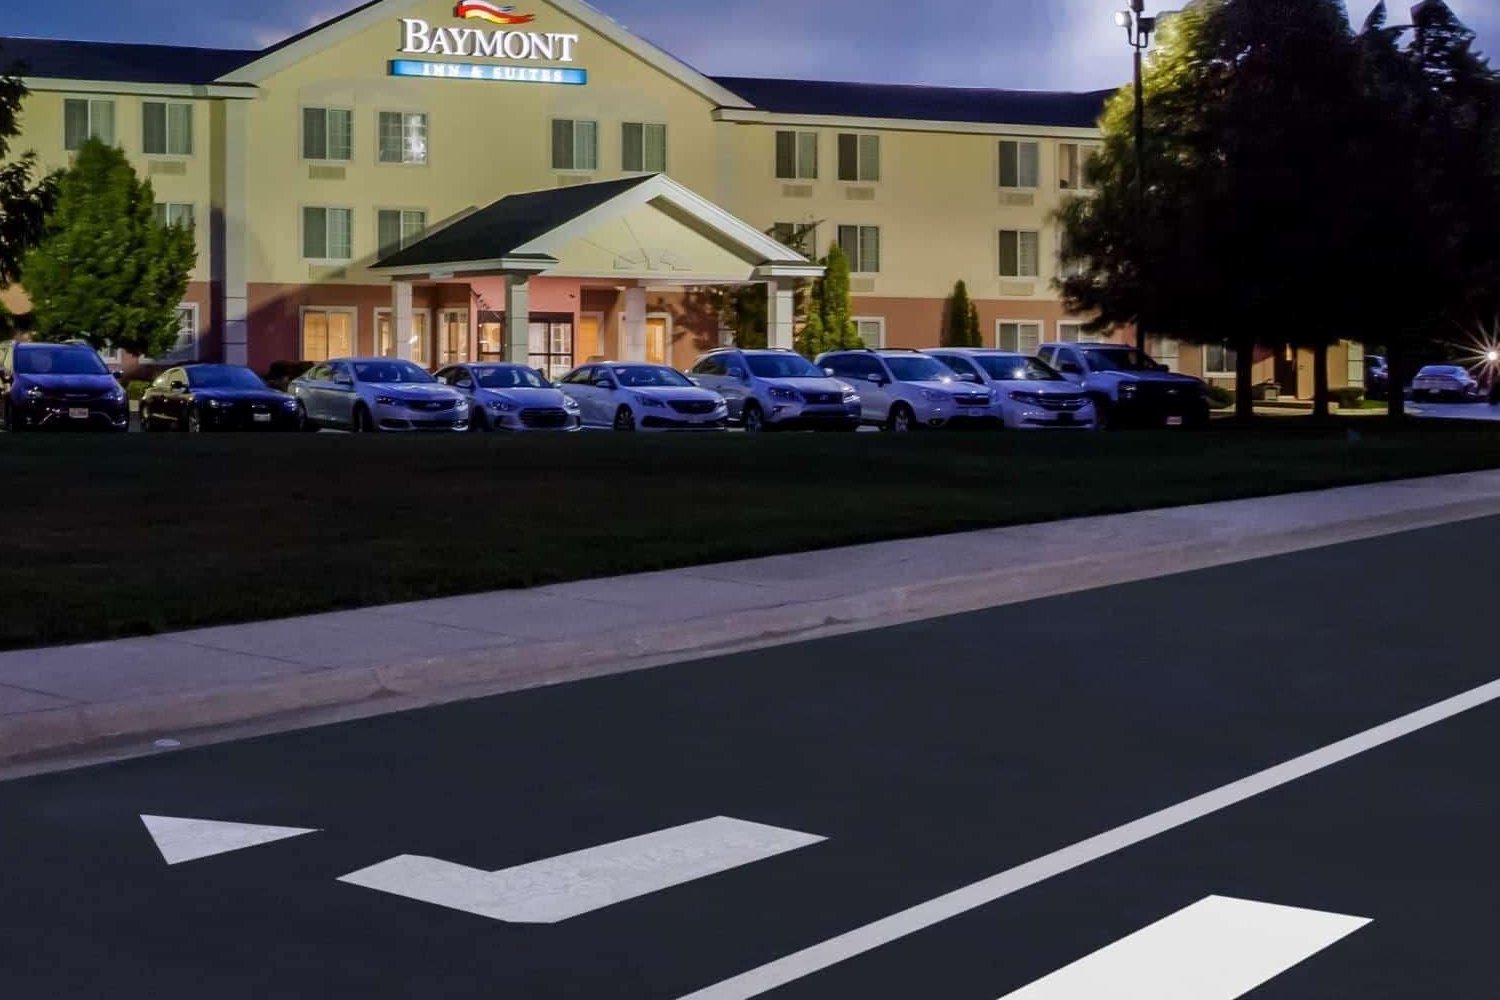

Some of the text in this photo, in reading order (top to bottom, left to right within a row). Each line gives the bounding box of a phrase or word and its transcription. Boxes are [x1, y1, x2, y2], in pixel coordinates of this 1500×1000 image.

[400, 18, 578, 62] BAYMONT
[422, 62, 564, 82] INN & SUITES
